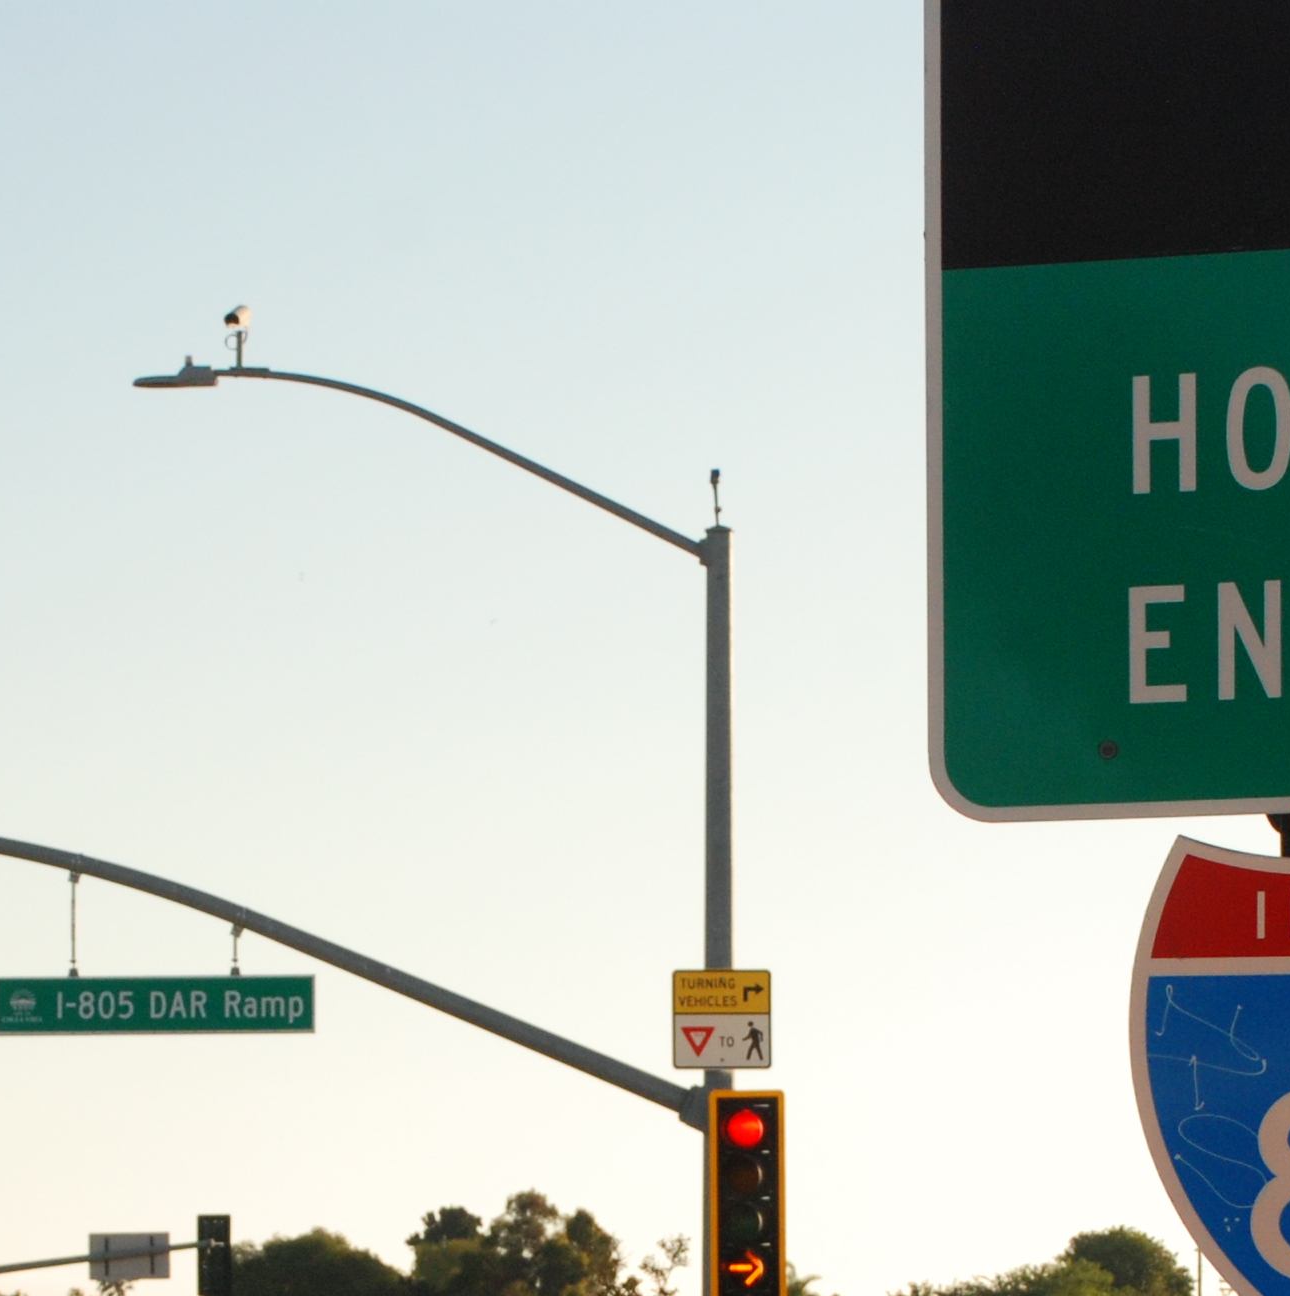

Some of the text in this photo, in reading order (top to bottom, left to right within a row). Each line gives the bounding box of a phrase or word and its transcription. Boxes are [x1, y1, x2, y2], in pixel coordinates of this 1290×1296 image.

[680, 977, 736, 989] TURNING
[57, 990, 304, 1023] I-805 DAR Ramp
[678, 995, 738, 1007] VEHICLES
[720, 1036, 735, 1047] TO
